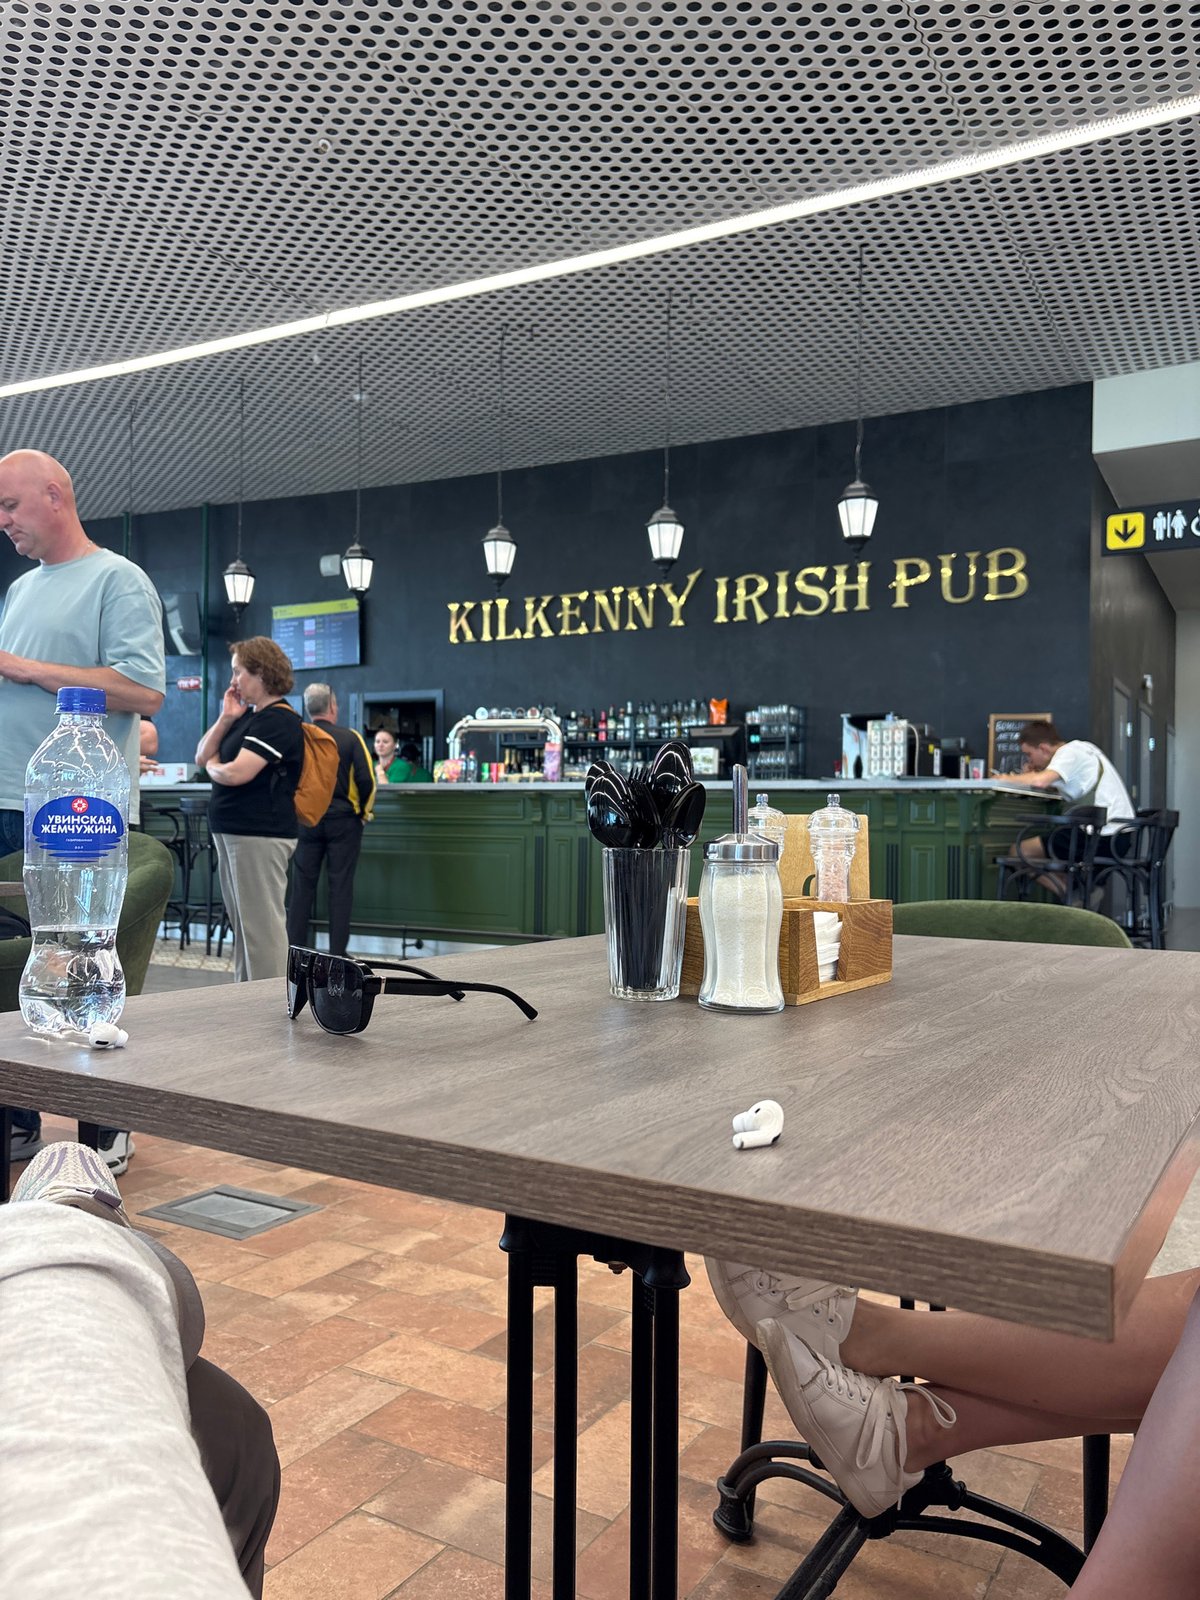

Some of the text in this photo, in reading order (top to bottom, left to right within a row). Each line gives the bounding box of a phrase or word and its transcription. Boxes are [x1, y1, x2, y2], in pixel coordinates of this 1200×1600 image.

[447, 547, 1029, 644] KILKENNY IRISH PUB
[47, 815, 112, 824] УВИНСКАЯ
[41, 824, 117, 834] ЖЕМЧУЖИНА
